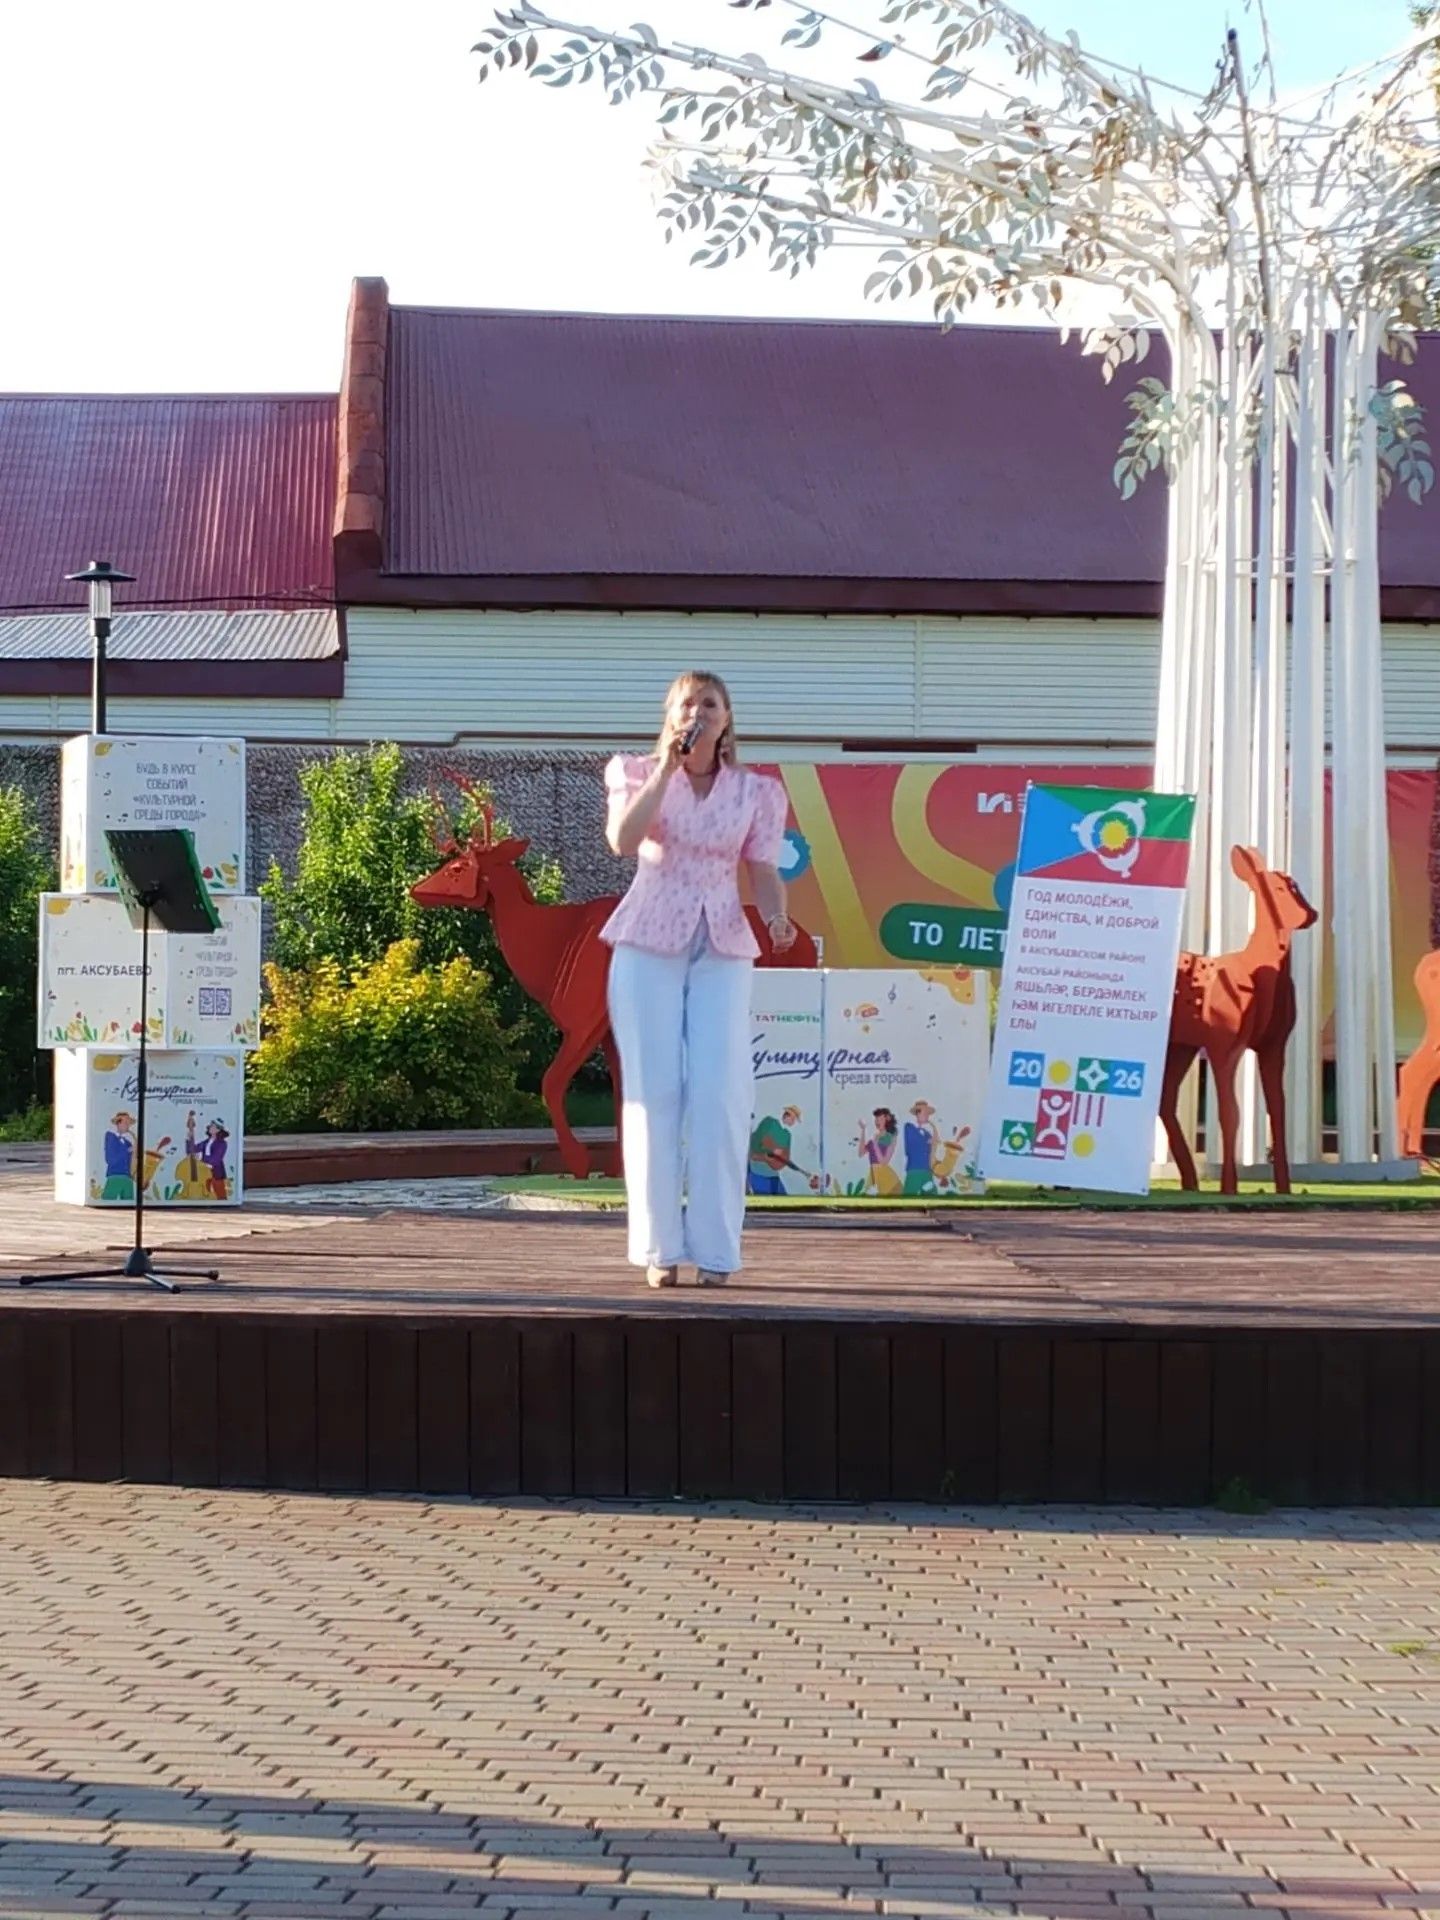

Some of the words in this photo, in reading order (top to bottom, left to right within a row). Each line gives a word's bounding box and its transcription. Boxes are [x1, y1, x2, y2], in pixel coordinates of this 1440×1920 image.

[136, 763, 160, 775] БУДЬ
[162, 763, 168, 775] В
[171, 764, 196, 775] КУРСЕ
[146, 778, 189, 790] СОБЫТИЙ
[134, 809, 163, 821] СРЕДЫ
[1027, 888, 1051, 904] ГОД
[1055, 892, 1133, 910] МОЛОДЁЖИ,
[1024, 909, 1092, 926] ЕДИНСТВА,
[1095, 915, 1104, 926] И
[1106, 916, 1160, 930] ДОБРОЙ
[909, 921, 943, 947] ТО
[1022, 928, 1057, 940] ВОЛИ
[1009, 1018, 1037, 1031] ЕЛЫ
[1013, 1058, 1042, 1079] 20
[1113, 1068, 1142, 1089] 26
[835, 1073, 871, 1090] среда
[874, 1073, 918, 1090] города
